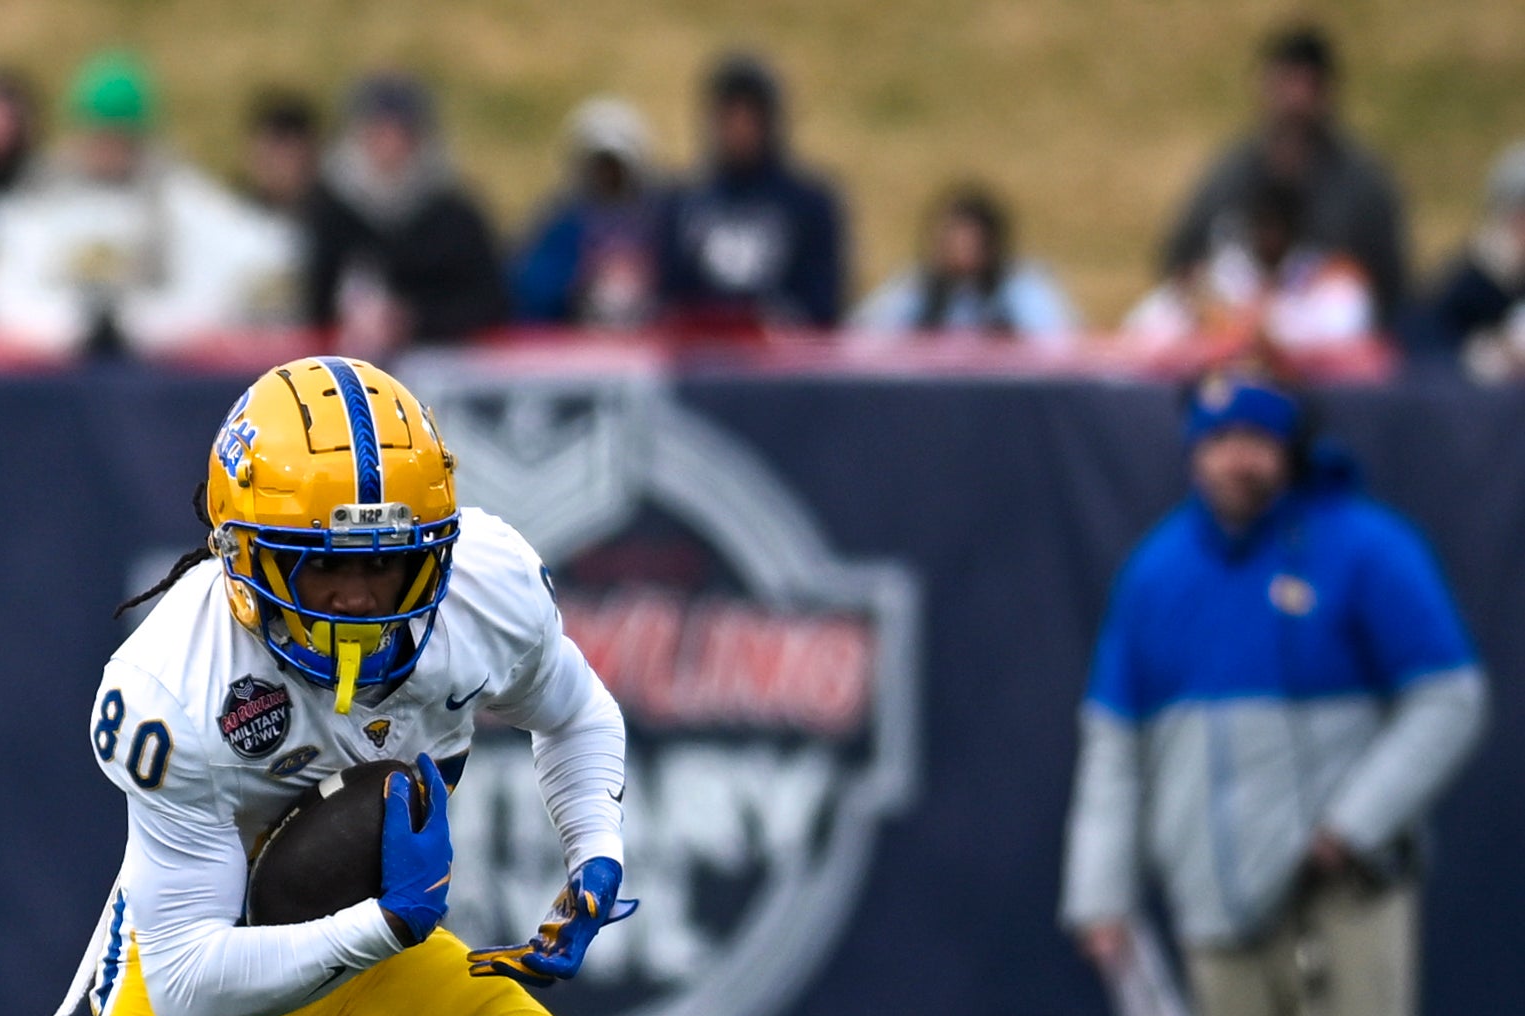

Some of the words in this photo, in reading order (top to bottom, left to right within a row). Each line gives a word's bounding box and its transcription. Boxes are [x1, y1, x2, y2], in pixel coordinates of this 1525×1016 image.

[359, 509, 383, 523] H2P
[94, 687, 174, 792] 80
[229, 706, 286, 744] MILITARY
